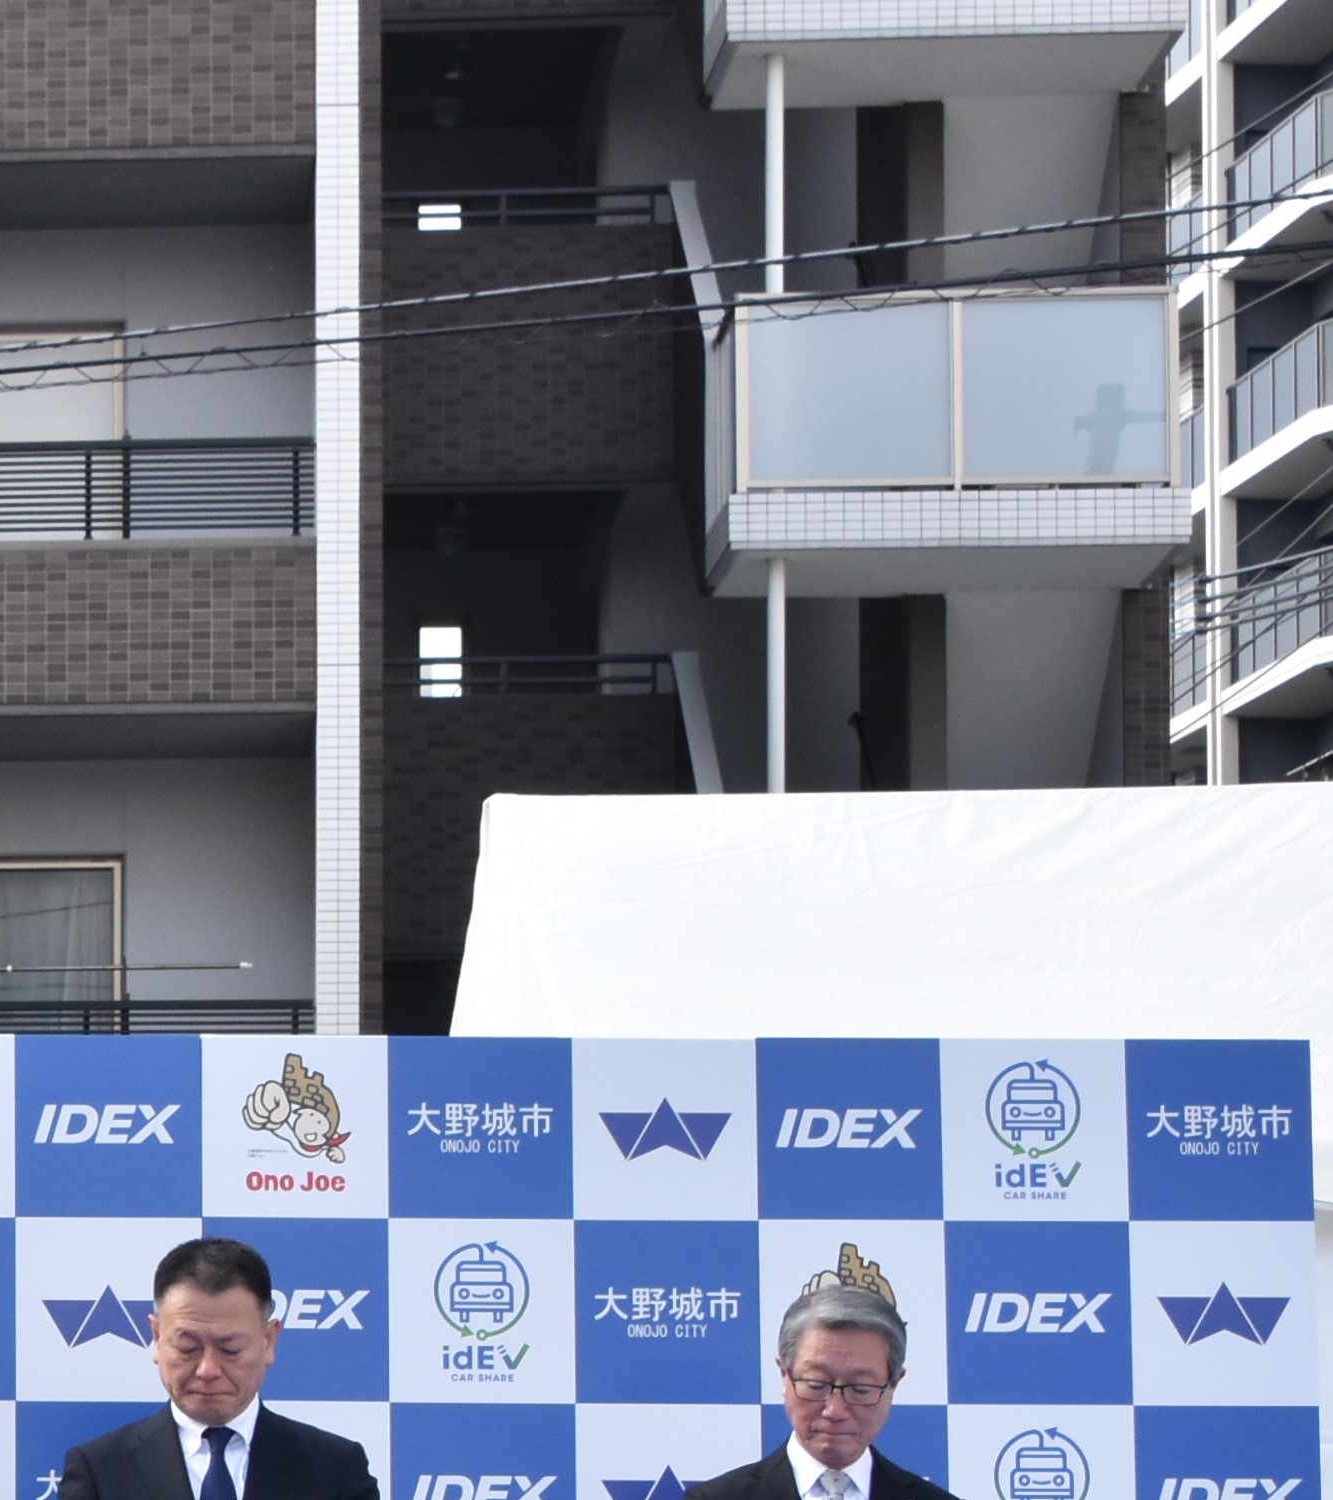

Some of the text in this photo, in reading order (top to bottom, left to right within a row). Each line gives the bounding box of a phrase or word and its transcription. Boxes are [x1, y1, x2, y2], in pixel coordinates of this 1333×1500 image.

[35, 1105, 180, 1143] IDEX
[408, 1103, 553, 1136] 大野城市
[776, 1109, 922, 1148] IDEX
[1147, 1105, 1291, 1139] 大野城市
[441, 1140, 519, 1153] ONOJO CITY
[1180, 1142, 1258, 1155] ONOJO CITY
[247, 1171, 345, 1192] Ono Joe
[269, 1289, 369, 1330] DEX
[595, 1287, 740, 1321] 大野城市
[965, 1293, 1111, 1332] IDEX
[628, 1324, 707, 1337] ONOJO CITY
